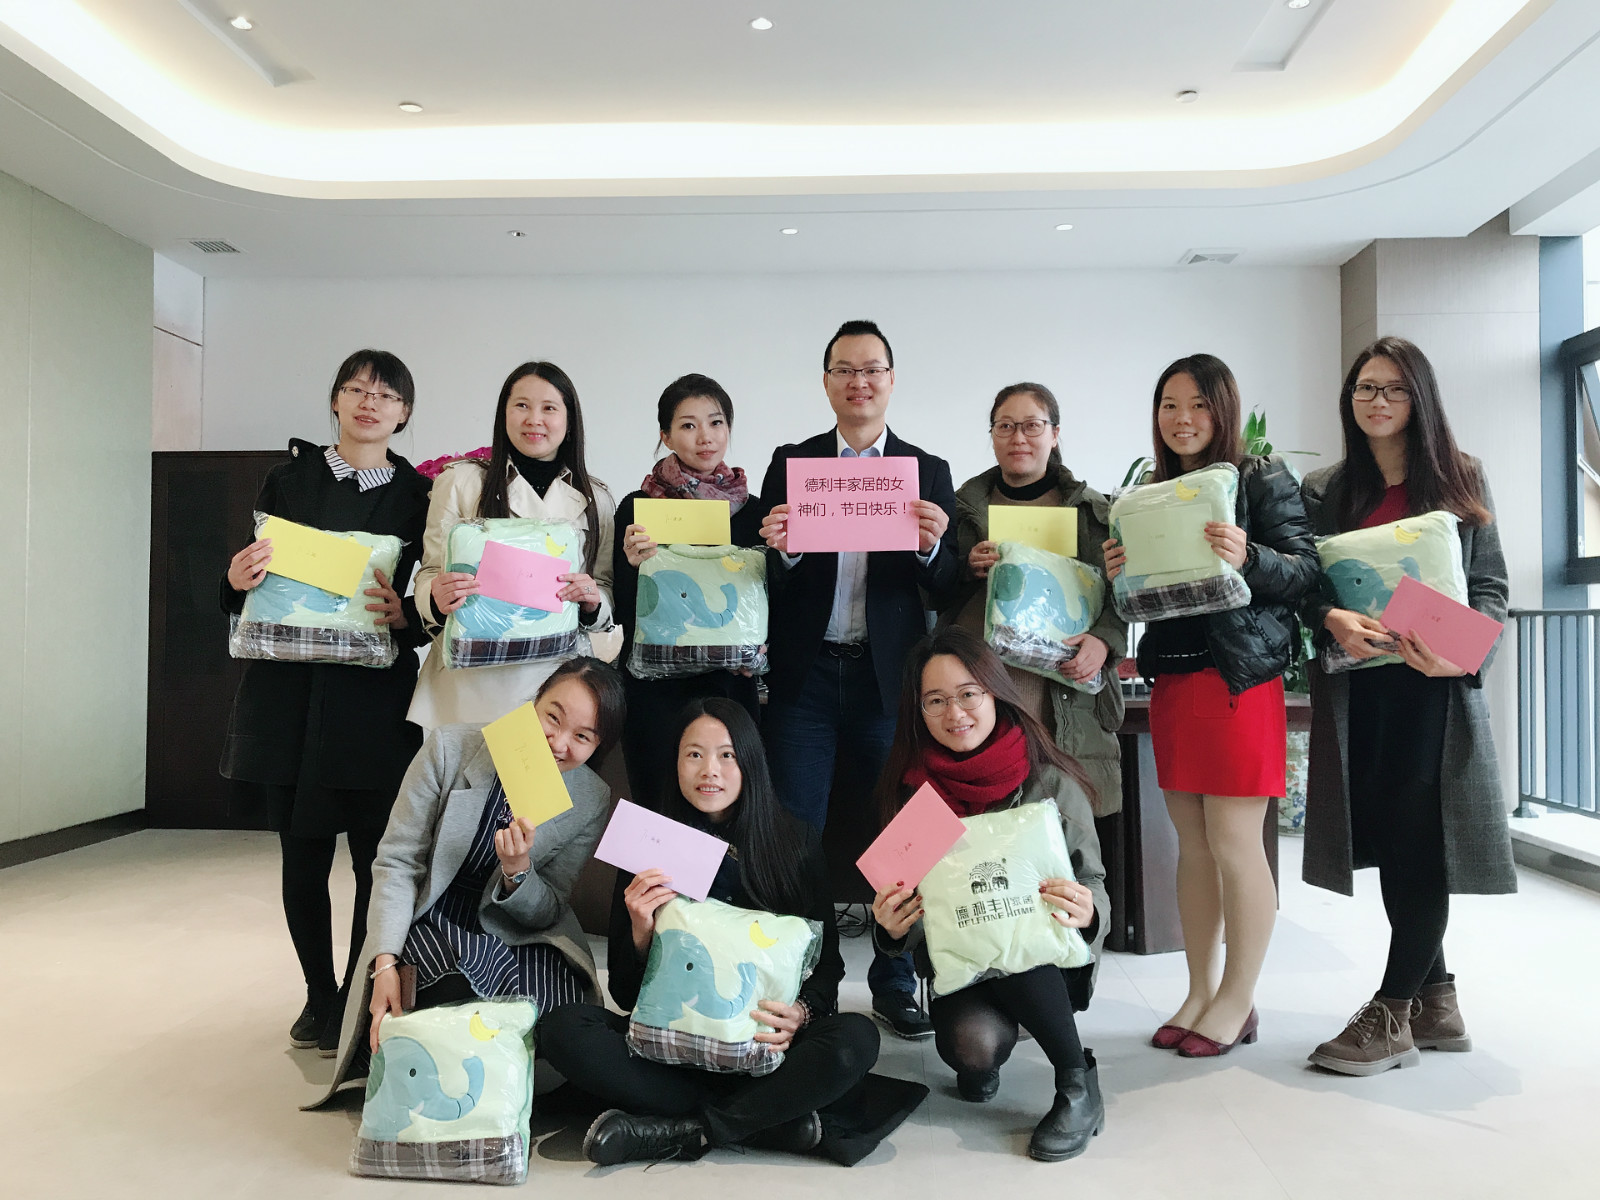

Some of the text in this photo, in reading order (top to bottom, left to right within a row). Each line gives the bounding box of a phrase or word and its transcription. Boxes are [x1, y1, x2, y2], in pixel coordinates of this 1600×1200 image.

[804, 476, 905, 493] 德利丰家居的女
[797, 501, 907, 517] 神们，节日快乐！
